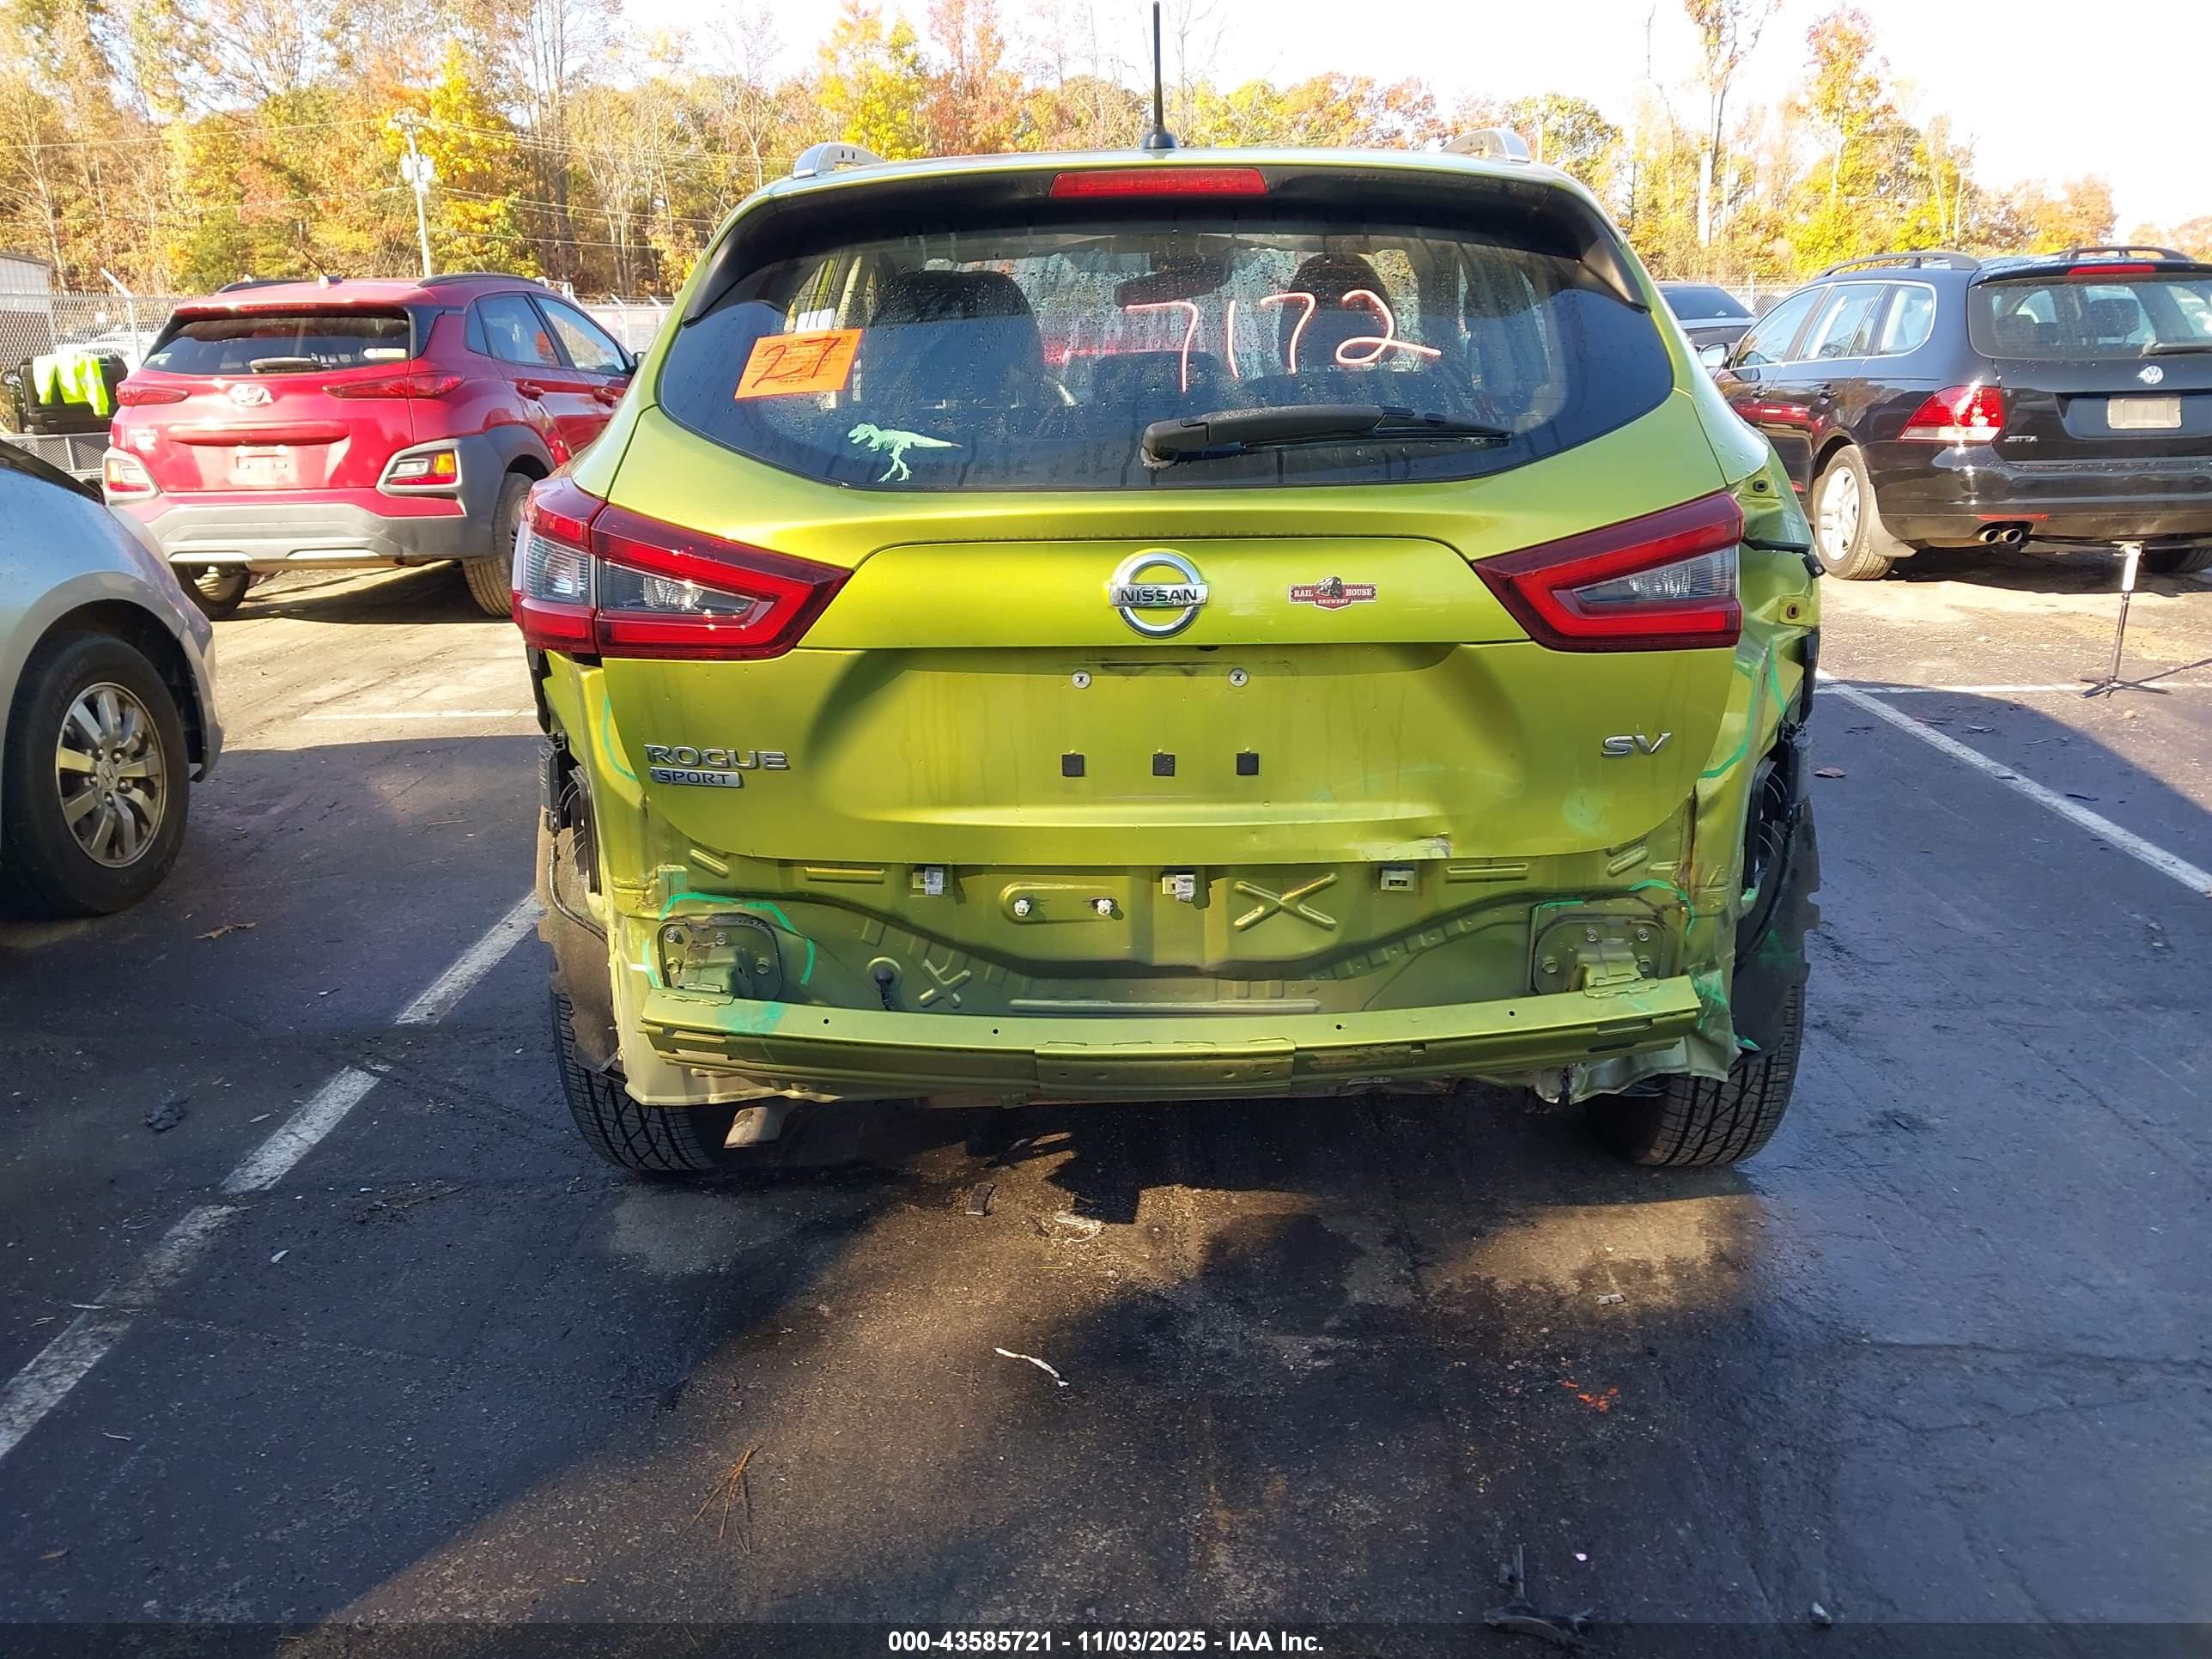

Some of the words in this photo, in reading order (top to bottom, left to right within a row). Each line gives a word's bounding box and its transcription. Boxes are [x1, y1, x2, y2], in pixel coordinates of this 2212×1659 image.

[1125, 289, 1443, 393] 7172
[1121, 588, 1198, 602] NISSAN
[644, 744, 791, 770] ROGUE
[1601, 732, 1672, 757] SV
[658, 769, 731, 785] SPORT
